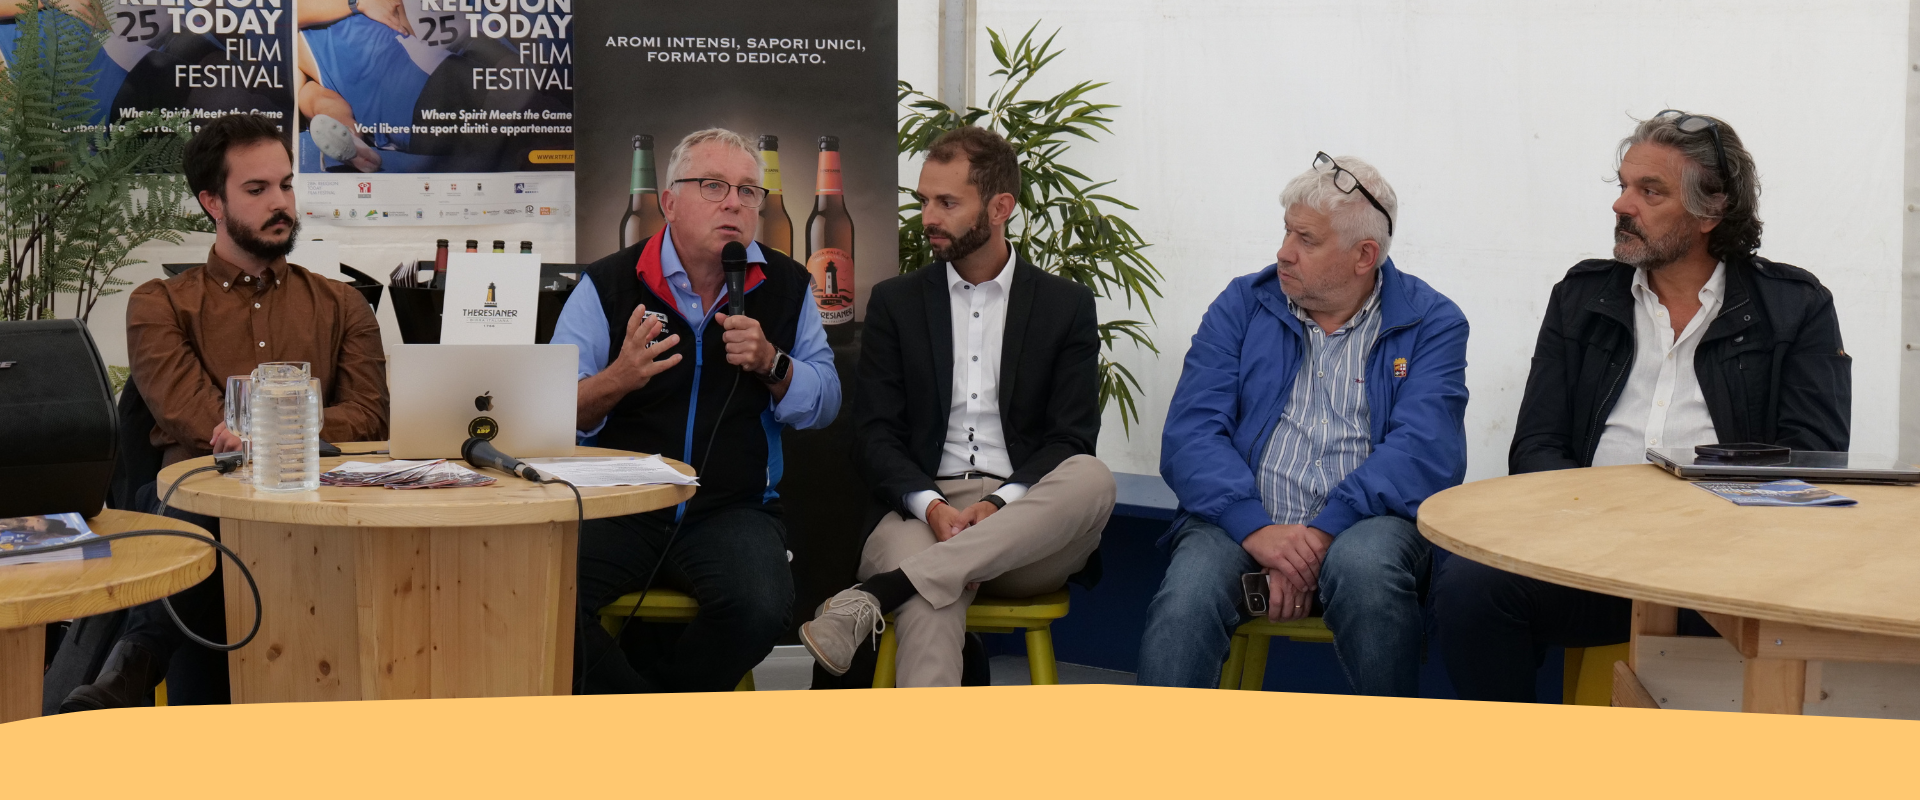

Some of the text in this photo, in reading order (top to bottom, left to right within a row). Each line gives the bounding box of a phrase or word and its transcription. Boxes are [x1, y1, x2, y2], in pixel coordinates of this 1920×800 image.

[117, 8, 160, 42] 25
[167, 7, 283, 35] TODAY
[418, 14, 459, 46] 25
[465, 13, 573, 39] TODAY
[225, 38, 282, 62] FILM
[519, 42, 572, 65] FILM
[605, 36, 866, 52] AROMI INTENSI, SAPORI UNICI,
[647, 51, 826, 64] FORMATO DEDICATO.
[175, 65, 283, 88] FESTIVAL
[472, 68, 573, 91] FESTIVAL
[192, 107, 227, 119] Meets
[421, 109, 573, 123] Where Spirit Meets the Game
[354, 122, 573, 136] Voci libere tra sport diritti e appartenenza
[463, 309, 517, 317] THERESIANER
[818, 307, 852, 319] RESIANER
